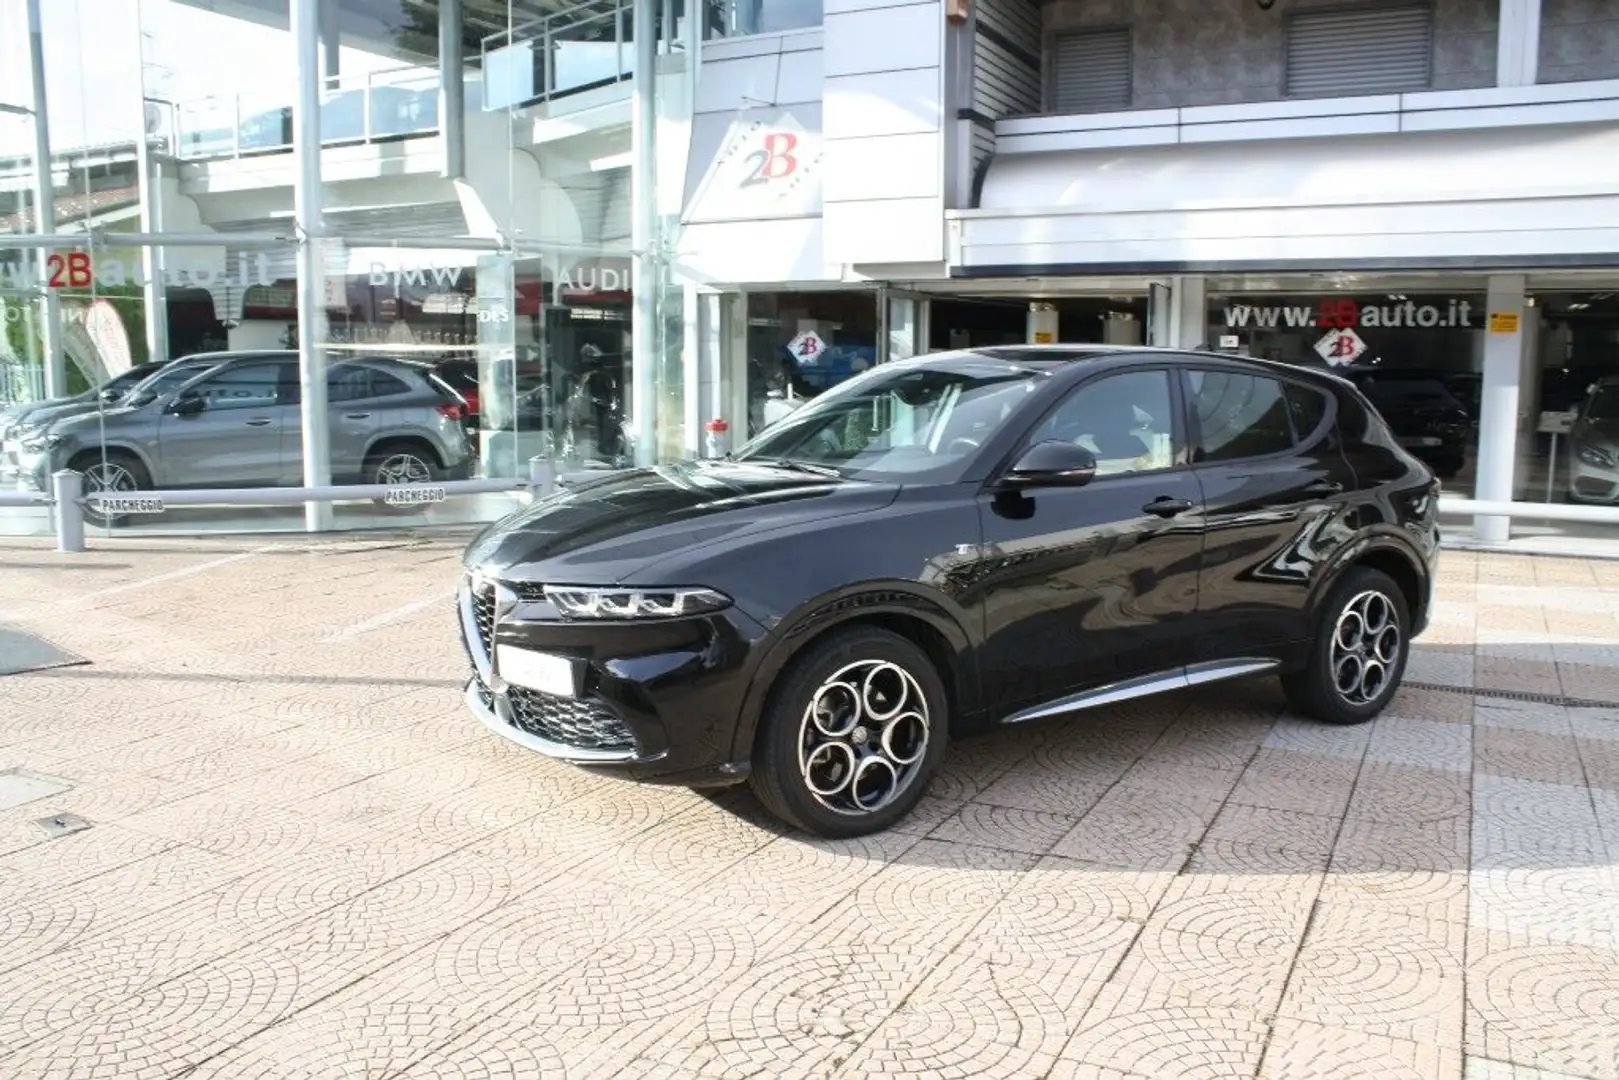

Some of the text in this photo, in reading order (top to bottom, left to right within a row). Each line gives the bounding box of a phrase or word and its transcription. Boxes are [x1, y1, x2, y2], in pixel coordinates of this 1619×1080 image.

[369, 262, 463, 288] BMW
[556, 267, 629, 292] AUDI
[1223, 299, 1472, 328] www.2Bauto.it
[102, 499, 164, 512] PARCHEGGIO
[385, 489, 444, 503] PARCHEGGIO
